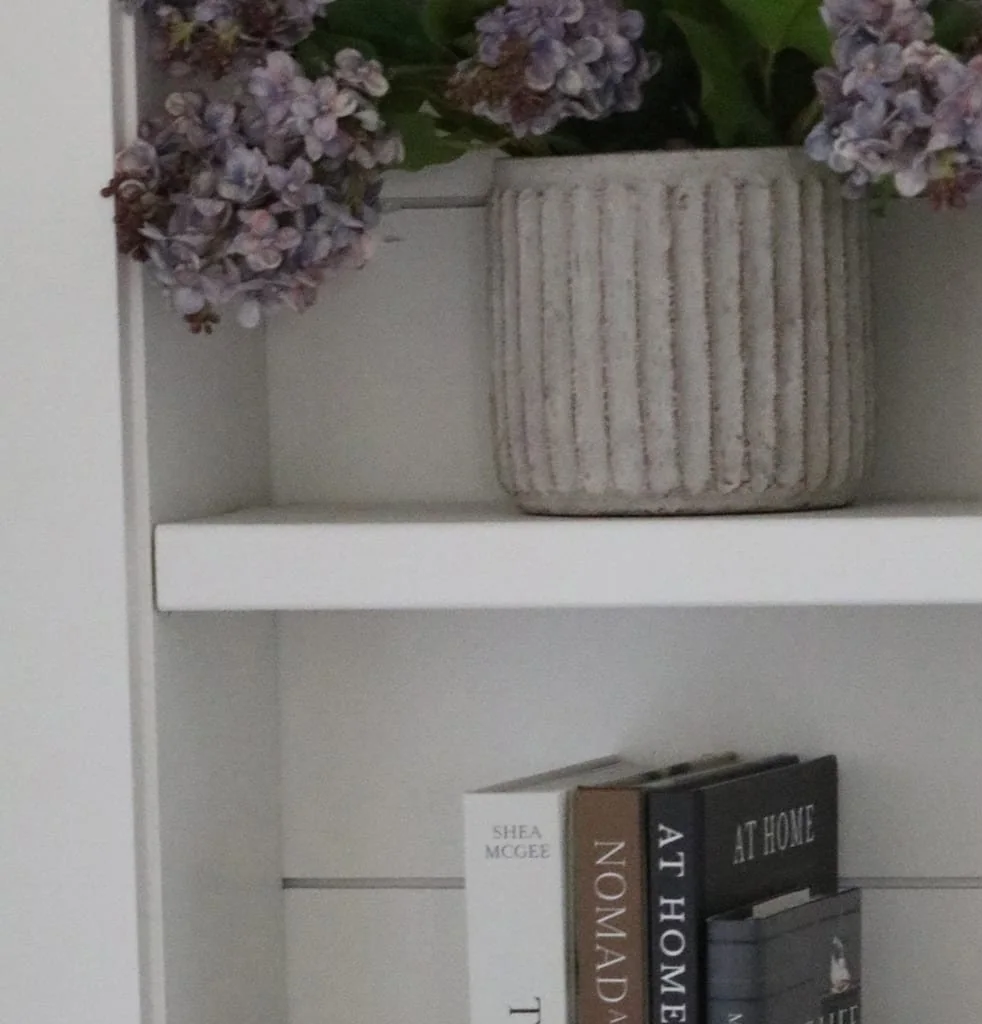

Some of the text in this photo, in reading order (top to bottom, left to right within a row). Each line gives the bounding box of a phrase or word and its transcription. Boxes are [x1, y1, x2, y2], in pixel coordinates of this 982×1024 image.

[492, 824, 543, 840] SHEA
[734, 804, 815, 866] AT HOME
[594, 840, 629, 1003] NOMAD
[658, 824, 687, 1024] AT HOME
